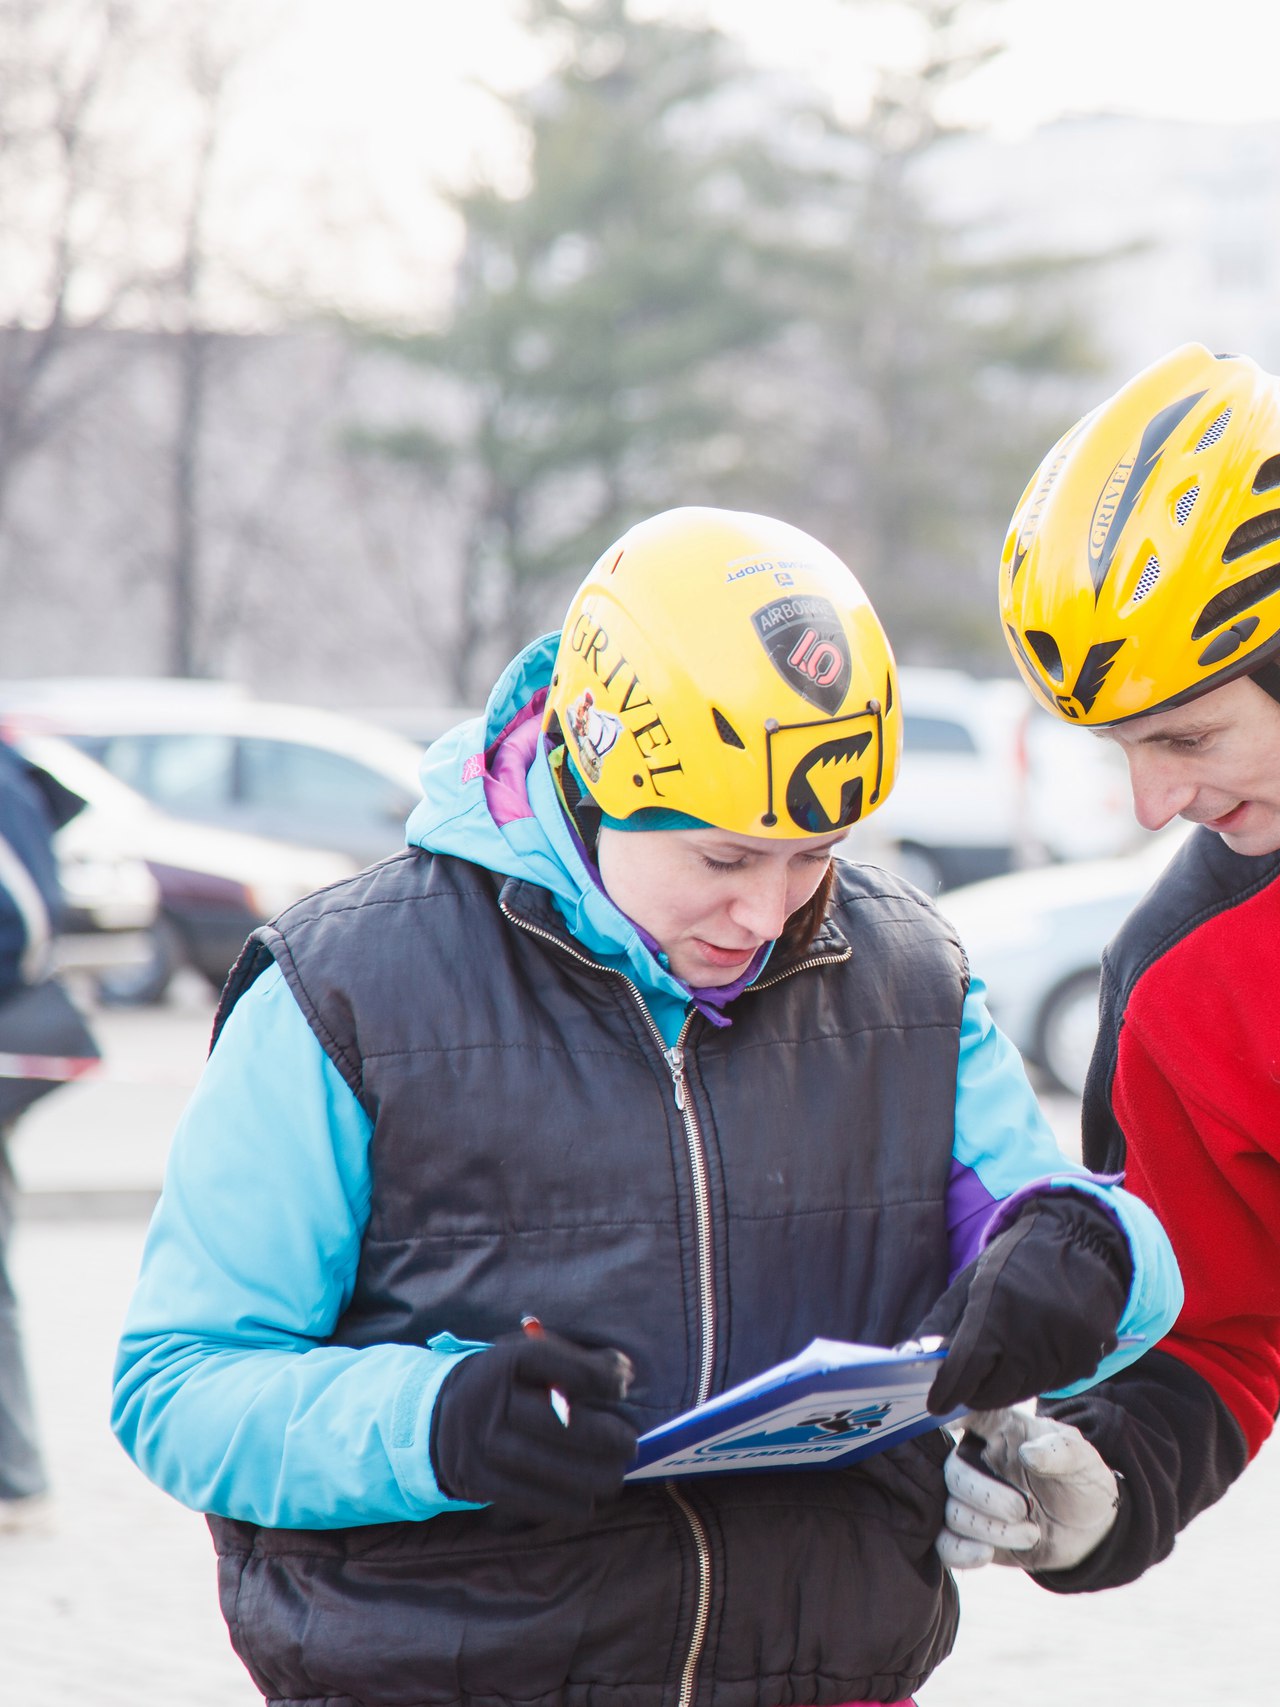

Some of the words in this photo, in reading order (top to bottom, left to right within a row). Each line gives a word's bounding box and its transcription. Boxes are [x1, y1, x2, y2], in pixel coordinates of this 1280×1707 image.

[1092, 457, 1136, 549] GRIVEL
[727, 562, 774, 582] СПОРТ
[572, 614, 684, 797] GRIVEL
